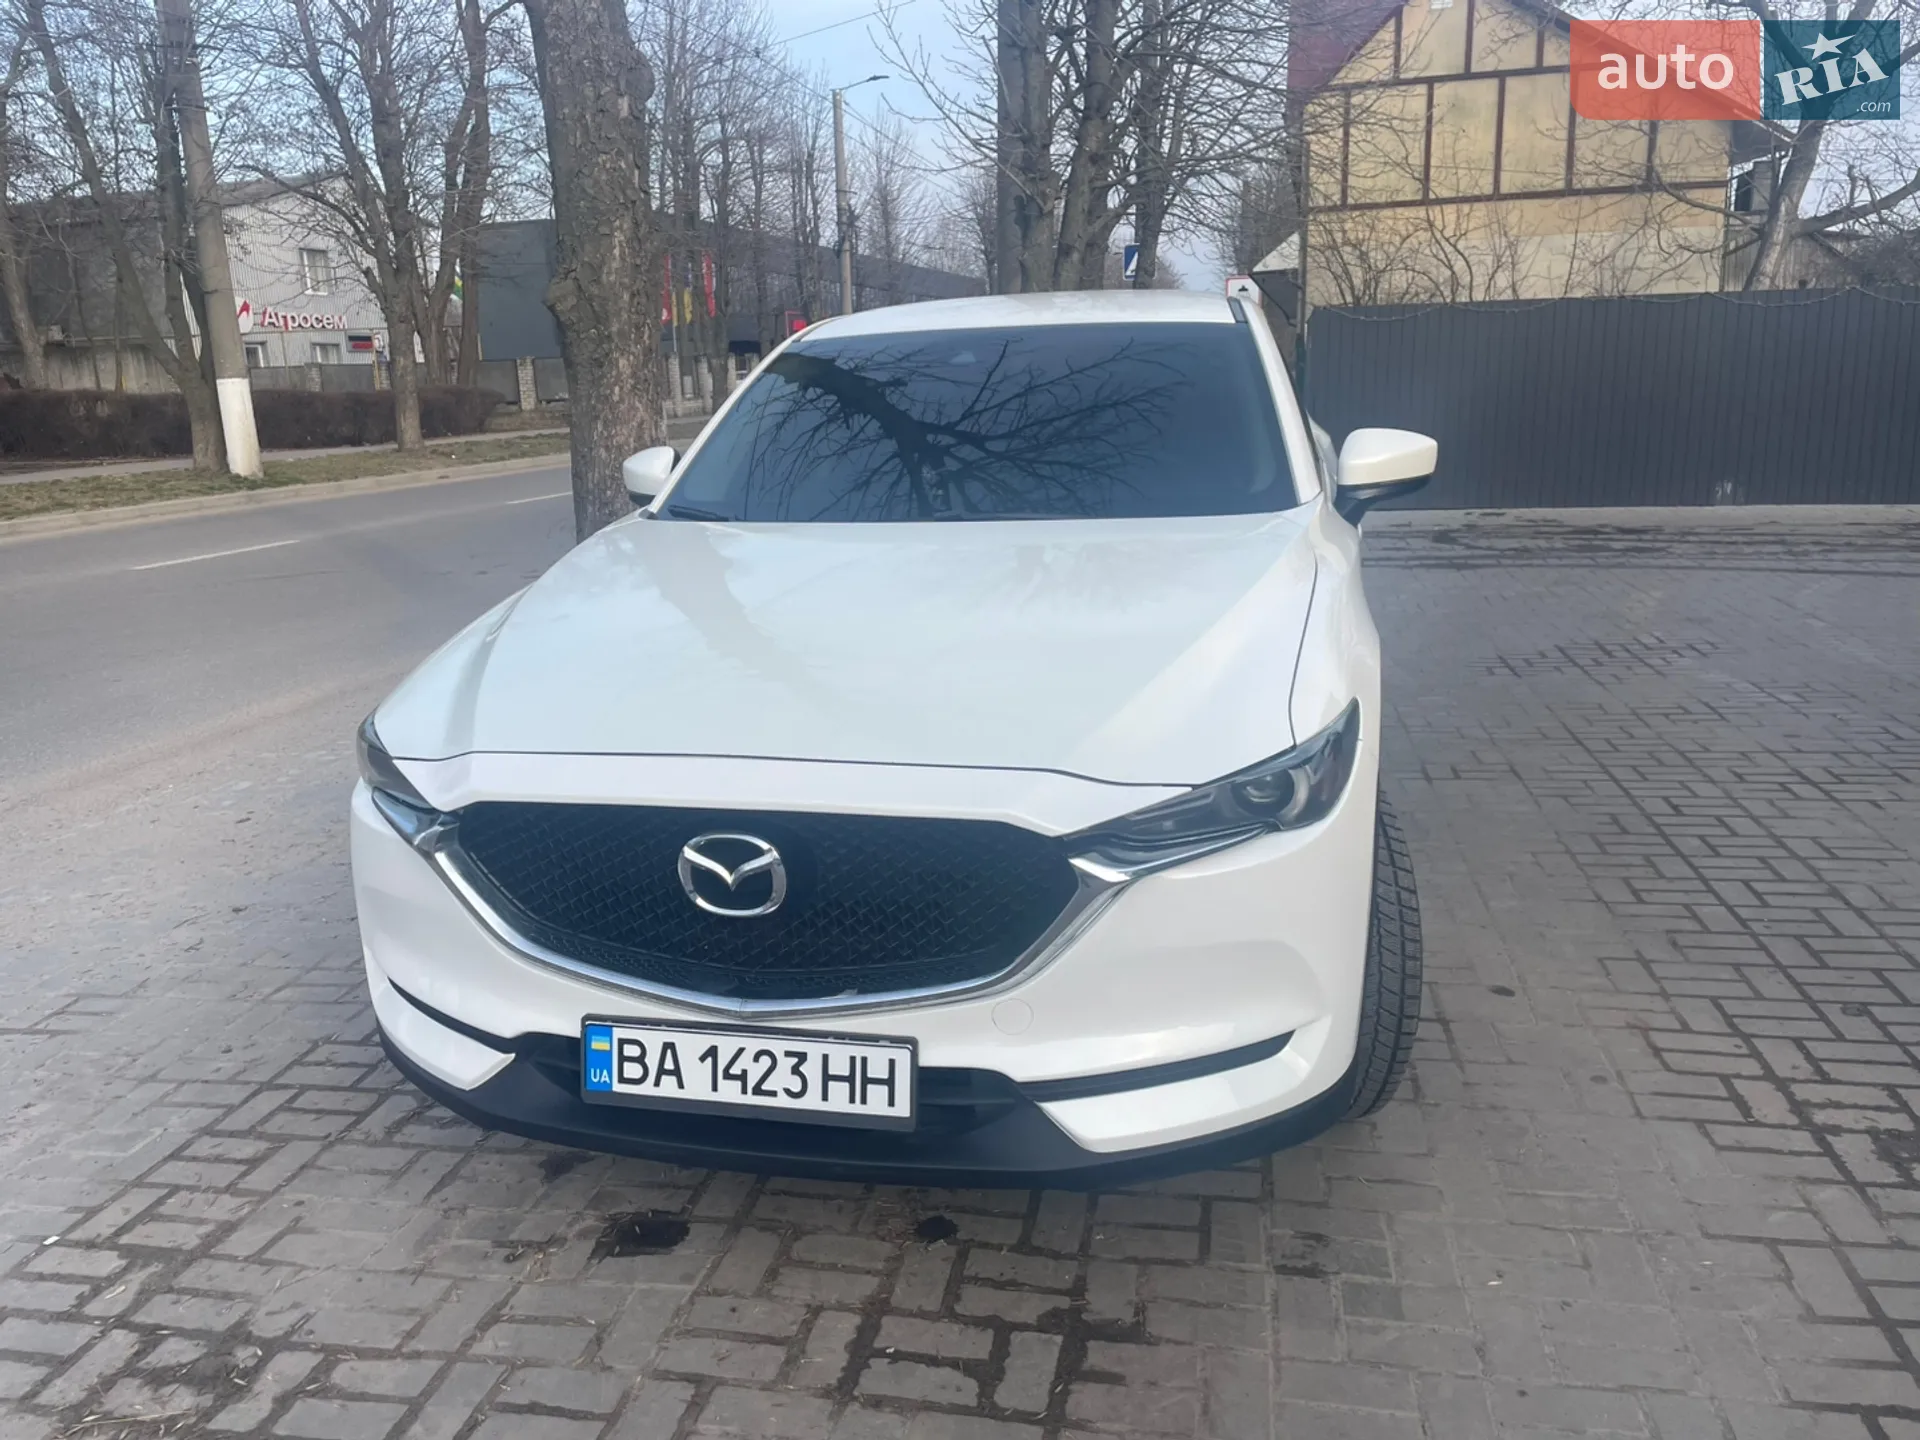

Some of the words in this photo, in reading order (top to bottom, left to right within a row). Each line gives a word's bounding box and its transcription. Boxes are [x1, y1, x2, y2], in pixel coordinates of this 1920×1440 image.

[260, 306, 348, 331] Агросем
[590, 1068, 611, 1084] UA
[617, 1037, 685, 1090] BA
[698, 1045, 808, 1099] 1423
[821, 1053, 896, 1108] HH
